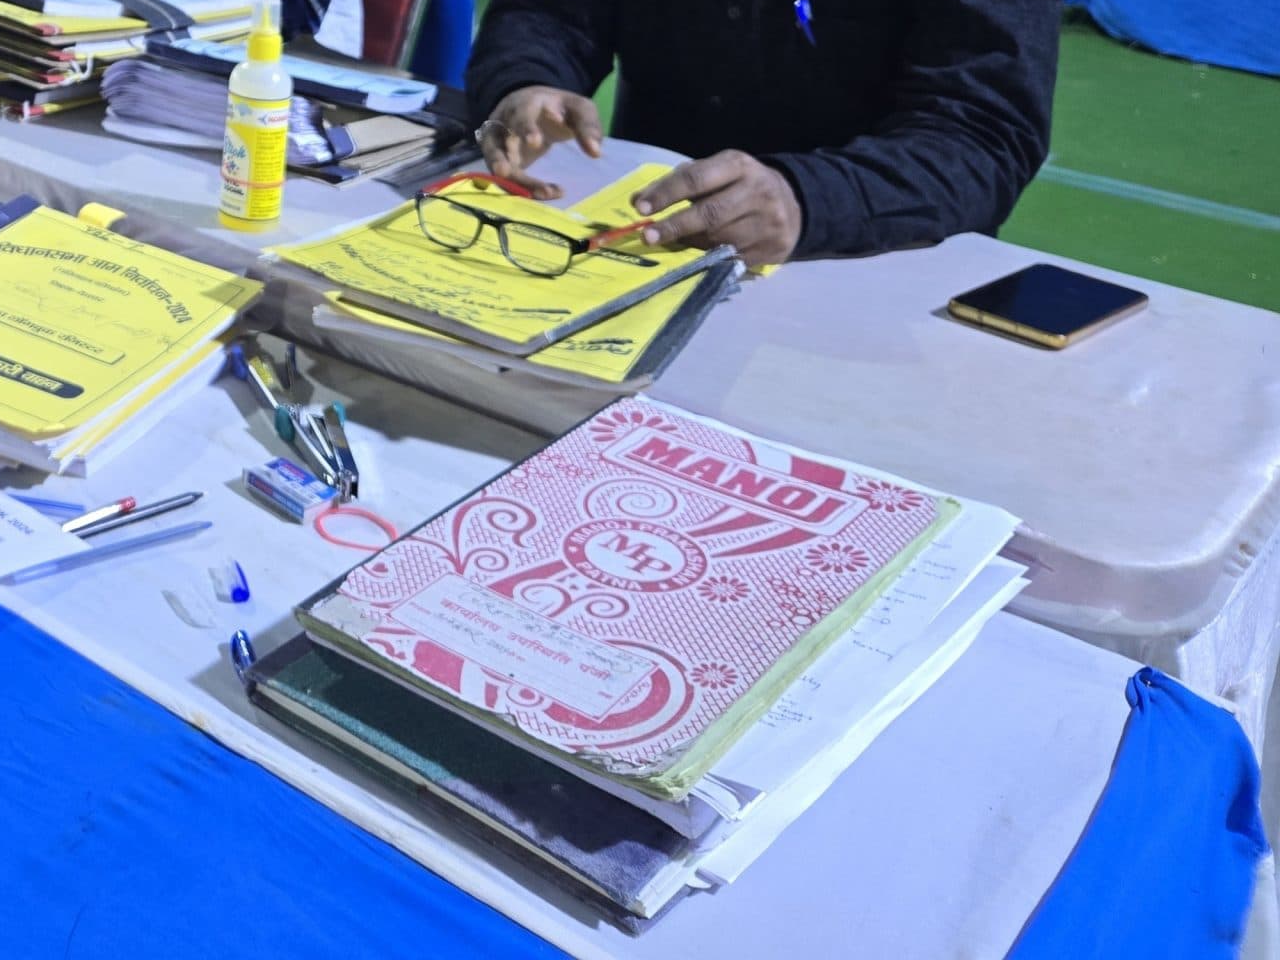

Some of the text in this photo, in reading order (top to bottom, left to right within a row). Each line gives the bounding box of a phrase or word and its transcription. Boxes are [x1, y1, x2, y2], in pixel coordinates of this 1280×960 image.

[86, 257, 122, 272] आम
[631, 436, 847, 524] MANOJ
[572, 520, 707, 586] MANOJ PRAKASHAN
[575, 561, 643, 591] PATNA
